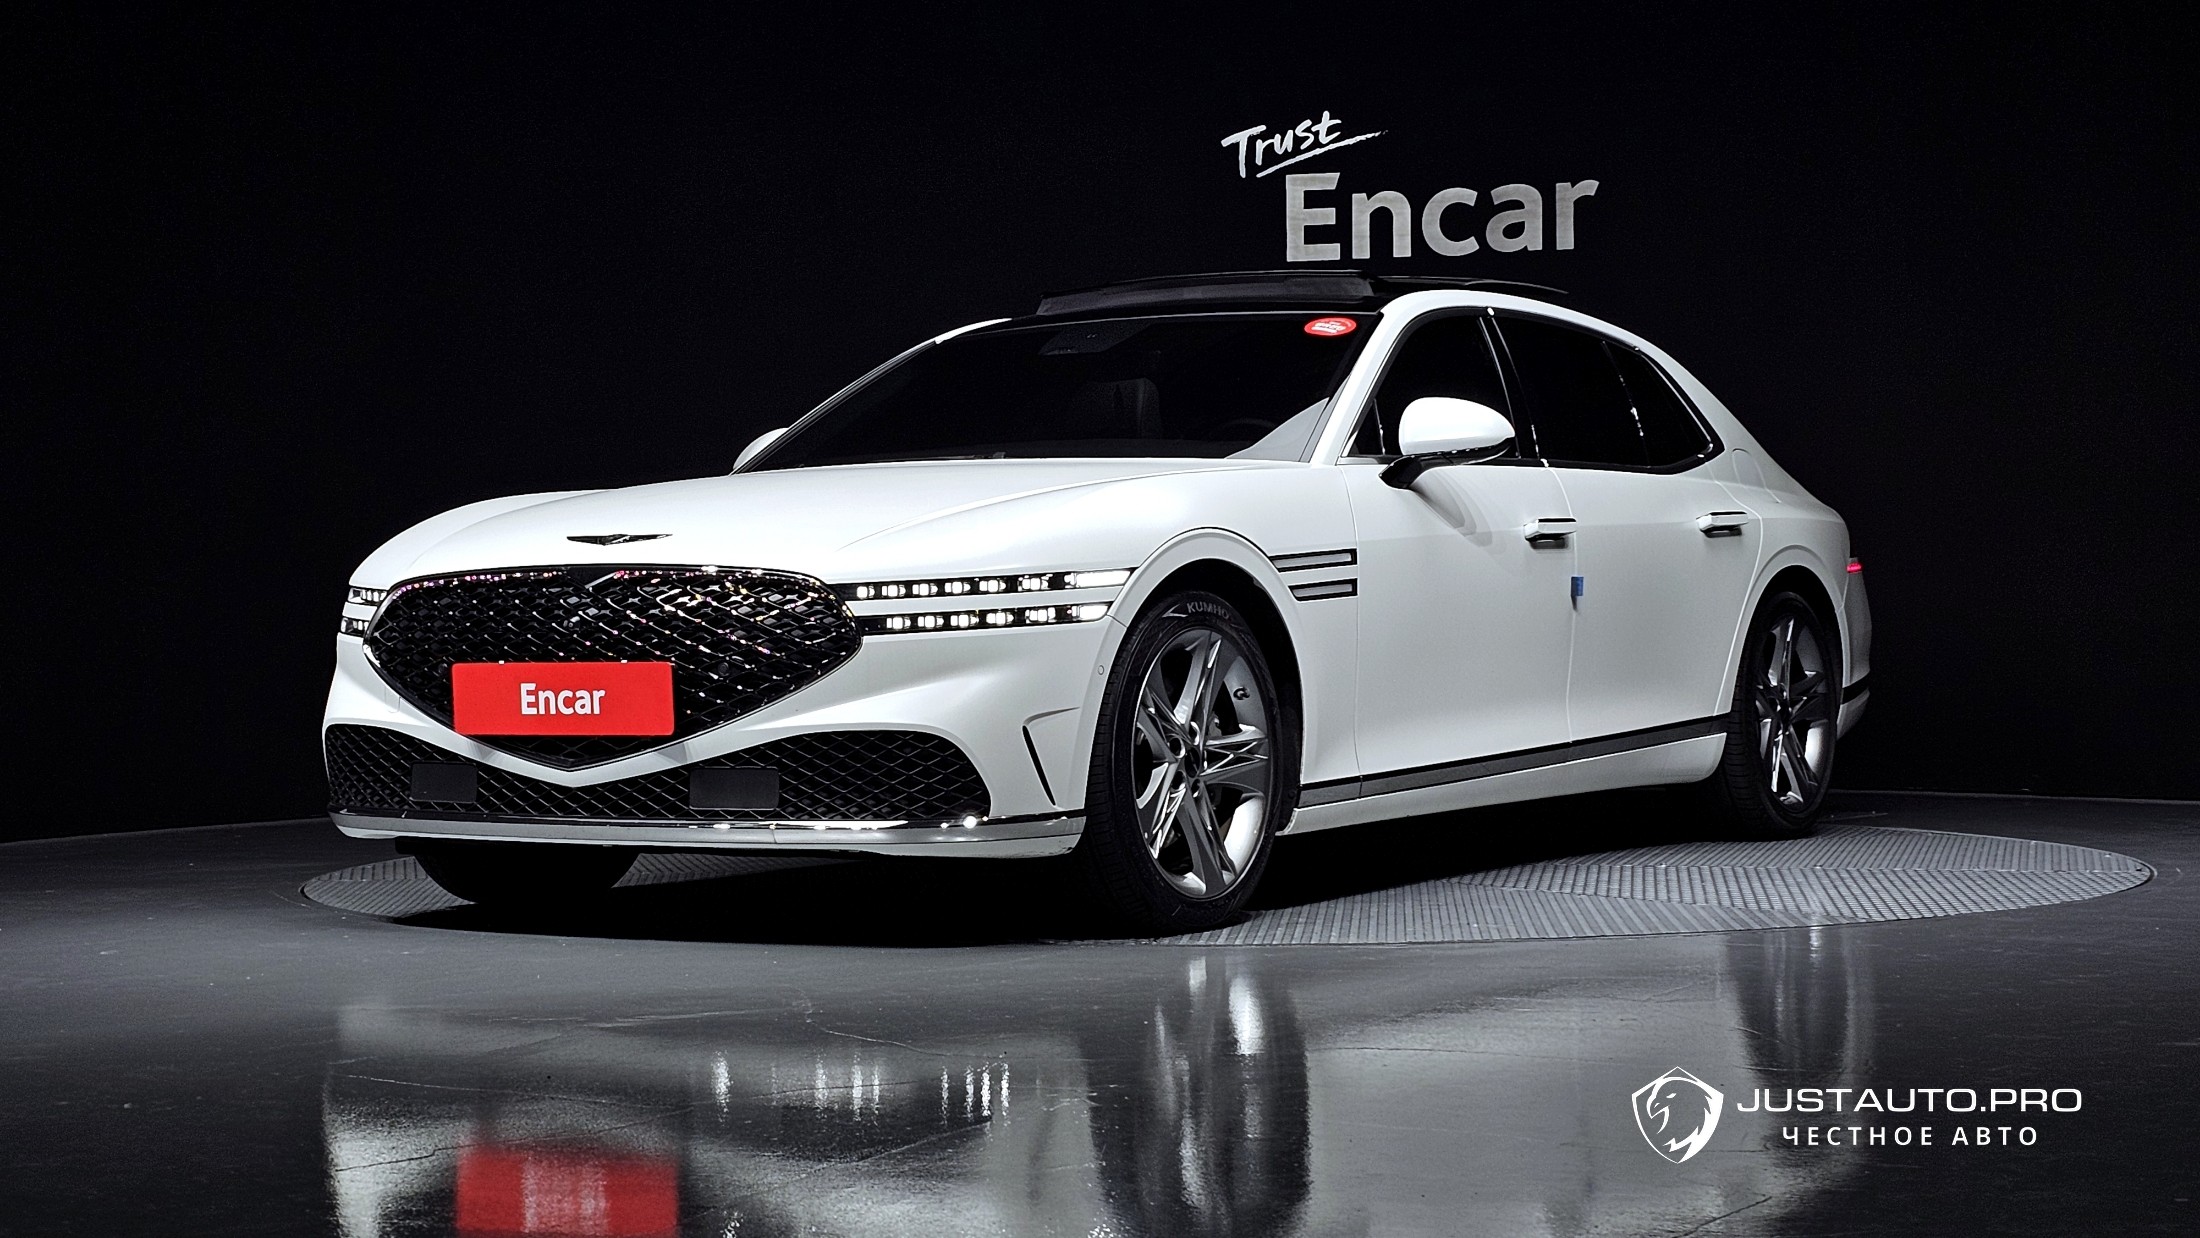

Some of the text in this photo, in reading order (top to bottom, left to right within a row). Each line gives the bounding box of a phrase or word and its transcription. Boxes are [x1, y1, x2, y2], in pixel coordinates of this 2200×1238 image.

[1221, 110, 1342, 178] Trust
[1285, 172, 1600, 262] Encar
[1186, 601, 1229, 620] KUMHO
[520, 682, 606, 715] Encar
